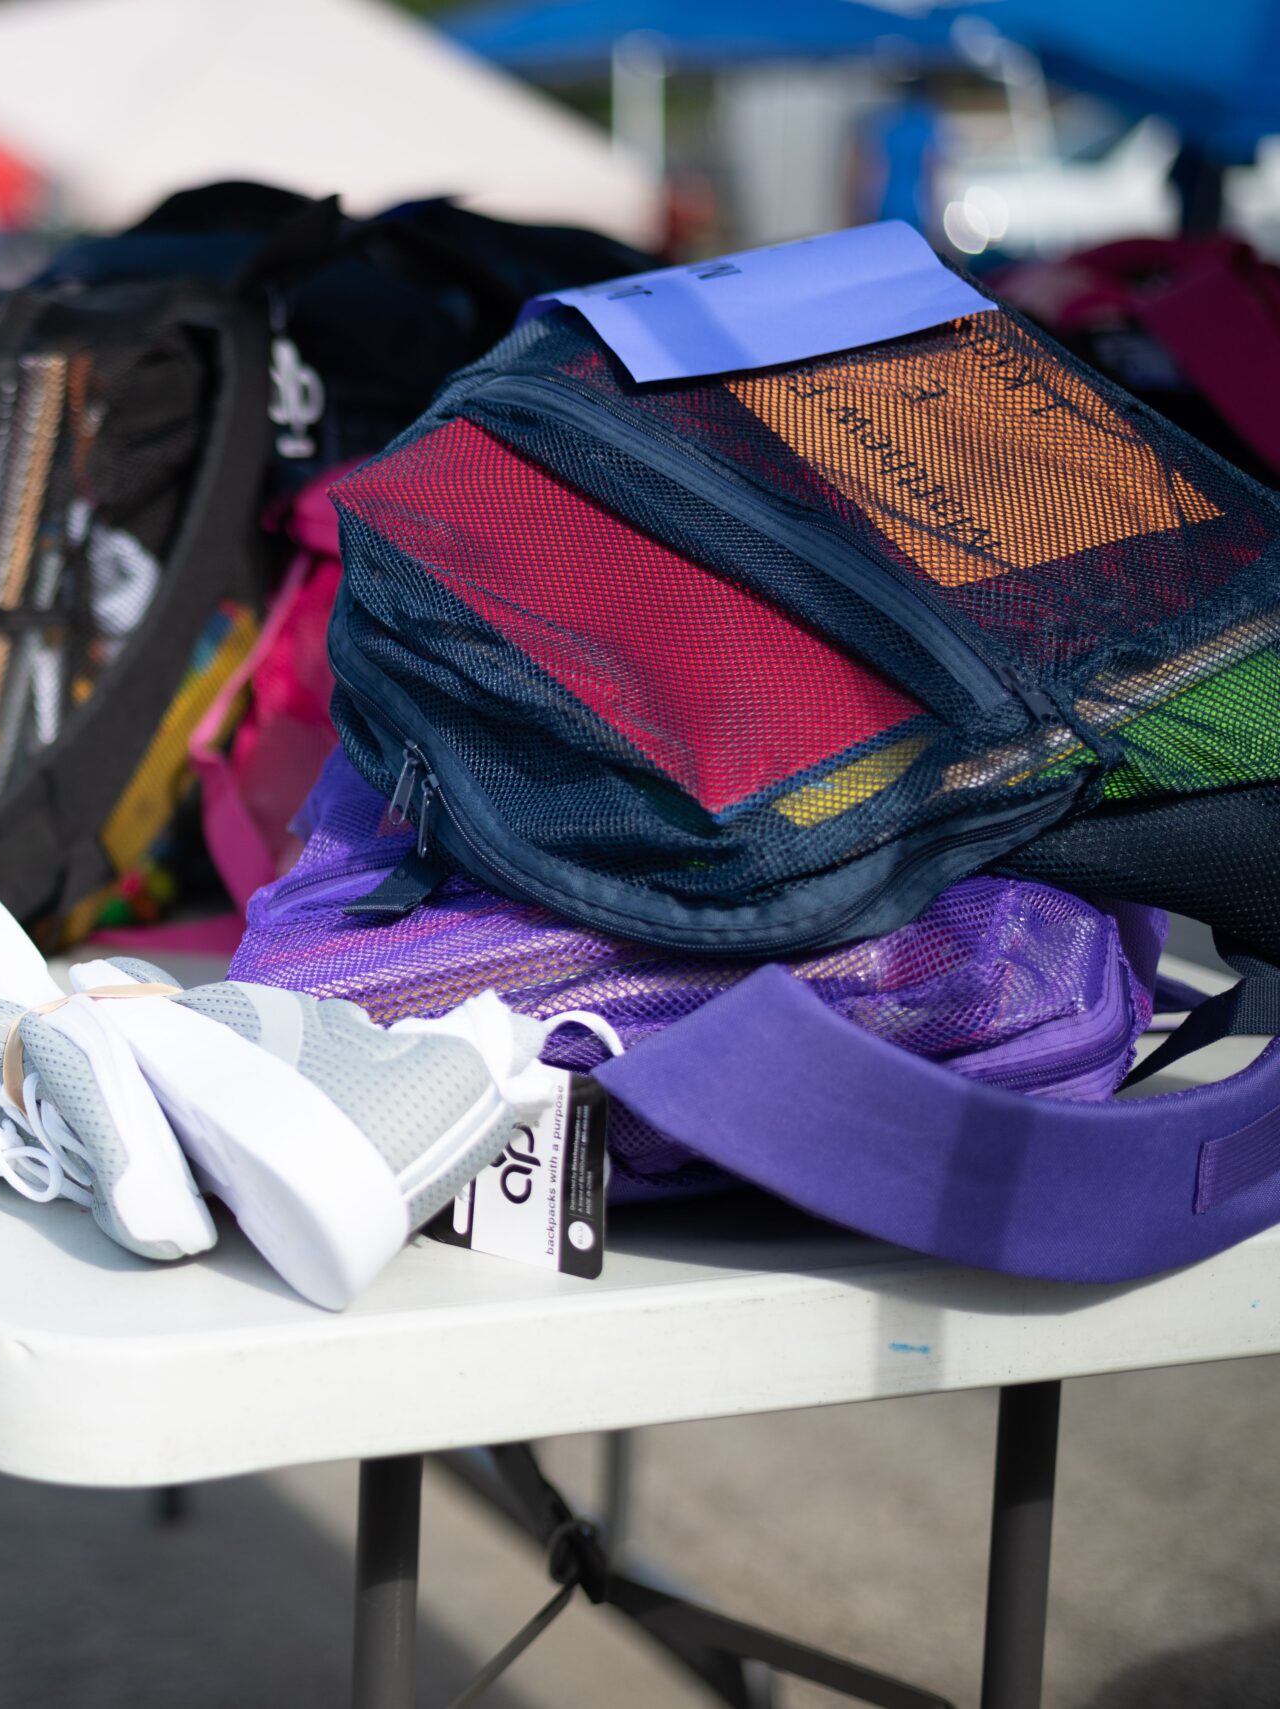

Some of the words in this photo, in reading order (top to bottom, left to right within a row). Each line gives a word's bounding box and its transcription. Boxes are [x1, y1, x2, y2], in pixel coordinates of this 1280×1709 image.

[825, 406, 1003, 552] Matthew
[553, 1085, 564, 1139] purpose
[548, 1156, 558, 1182] with
[552, 1143, 559, 1151] a
[545, 1188, 557, 1255] backpacks
